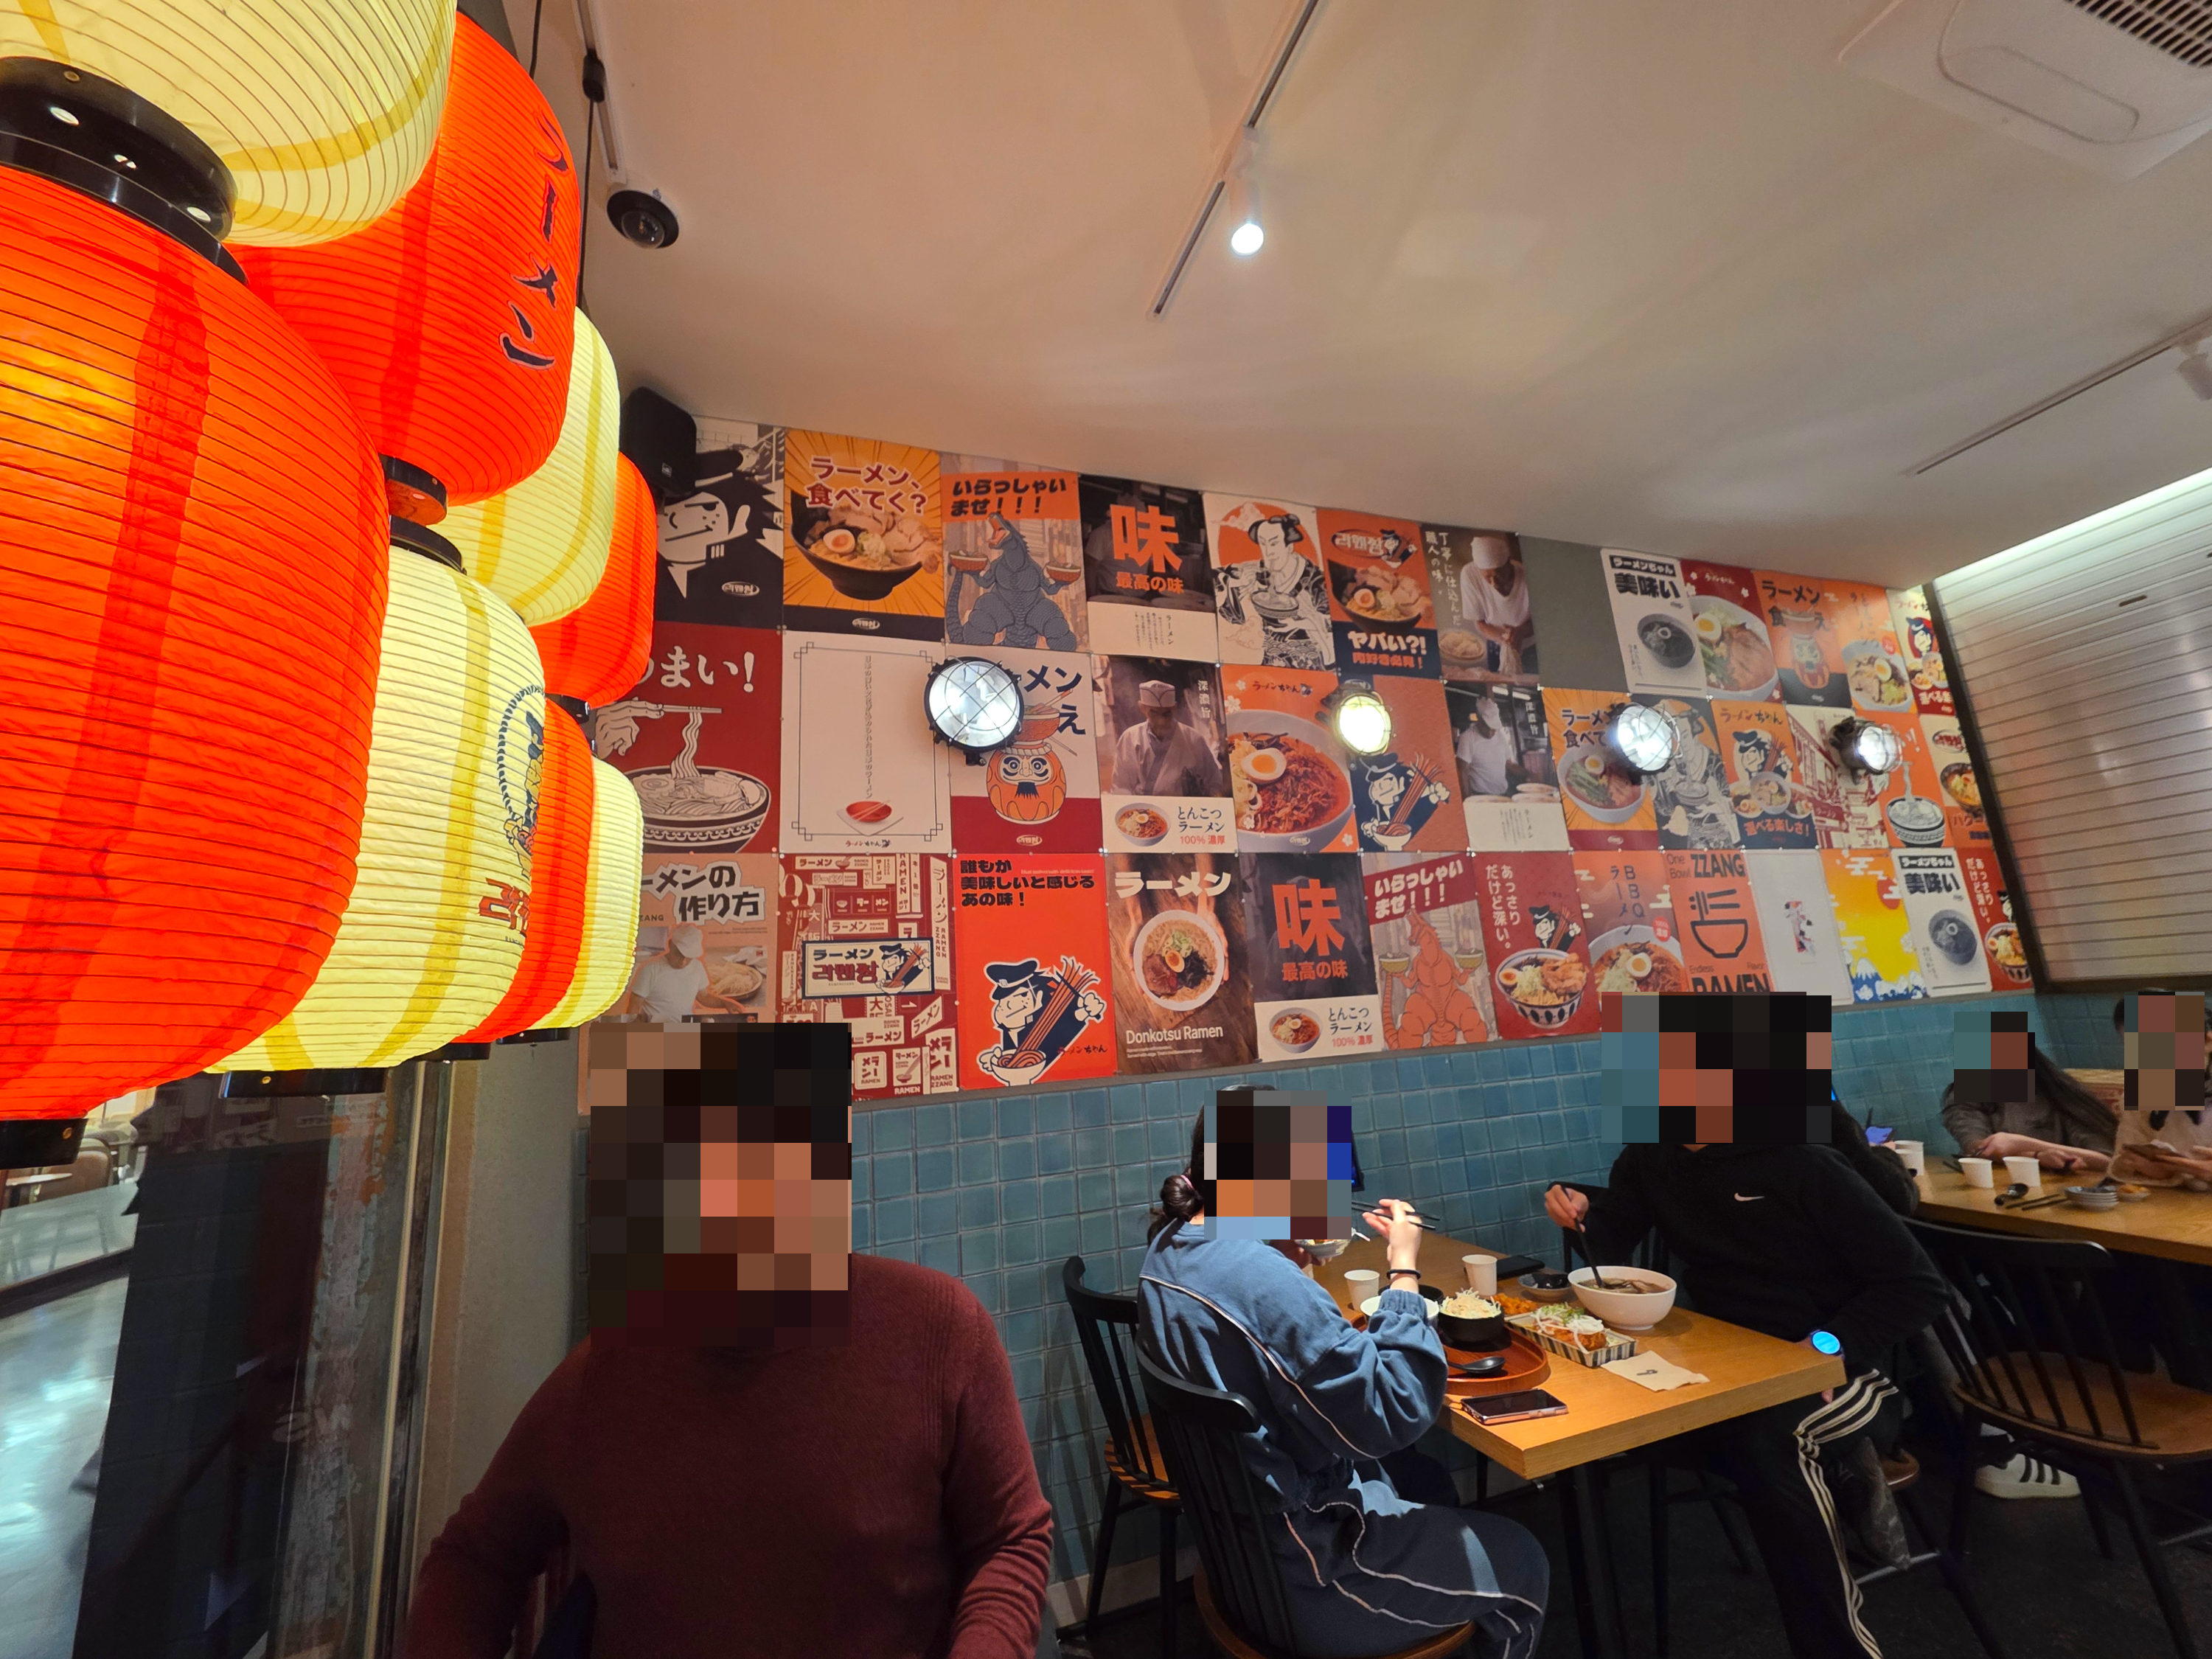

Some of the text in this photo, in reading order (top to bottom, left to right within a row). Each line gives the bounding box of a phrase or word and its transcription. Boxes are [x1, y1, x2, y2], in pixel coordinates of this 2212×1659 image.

[500, 109, 570, 369] ラーメン
[811, 456, 920, 490] ラーメン、
[807, 482, 927, 515] 食べてく?
[953, 478, 1067, 496] いらっしゃい
[950, 496, 1042, 516] ませ!!!
[1110, 504, 1183, 573] 味
[1116, 571, 1185, 594] 最高の味
[1614, 572, 1681, 599] 美味い
[1761, 580, 1820, 605] ラーメン
[1347, 630, 1427, 655] ヤバい?!
[639, 645, 755, 692] まい!
[1023, 664, 1082, 693] メン
[1057, 703, 1086, 735] え
[1178, 805, 1222, 821] とんこつ
[1178, 821, 1225, 834] ラーメン
[1743, 818, 1809, 837] 選べる楽しさ!
[1180, 834, 1226, 846] 100% 濃厚
[799, 858, 832, 867] ラーメン
[960, 860, 1012, 874] 誰もが
[1666, 854, 1686, 866] One
[1690, 853, 1746, 878] ZZANG
[899, 853, 907, 895] RAMEN
[961, 875, 1095, 890] 美味しいと感じる
[1115, 872, 1231, 899] ラーメン
[1374, 859, 1464, 898] いらっしゃい
[1904, 872, 1961, 894] 美味い
[961, 891, 1025, 906] あの味!
[1375, 883, 1445, 919] ませ!!!
[1501, 864, 1520, 926] あっさり
[1624, 865, 1646, 919] BBQ
[678, 891, 760, 922] 作り方
[1272, 879, 1345, 956] 味
[1486, 863, 1511, 949] だけど深い。
[832, 921, 867, 933] ラーメン
[813, 948, 874, 961] ラーメン
[812, 960, 880, 984] 라멘짱
[1281, 959, 1349, 982] 最高の味
[914, 1004, 940, 1034] ラーメン
[1328, 1007, 1370, 1023] とんこつ
[866, 1031, 902, 1044] ラーメン
[1126, 1026, 1223, 1044] Donkotsu Ramen
[1329, 1021, 1372, 1036] ラーメン
[1332, 1037, 1356, 1047] 100%
[895, 1051, 919, 1060] ラーメン
[894, 1086, 920, 1095] RAMEN
[930, 1080, 953, 1088] ZZANG
